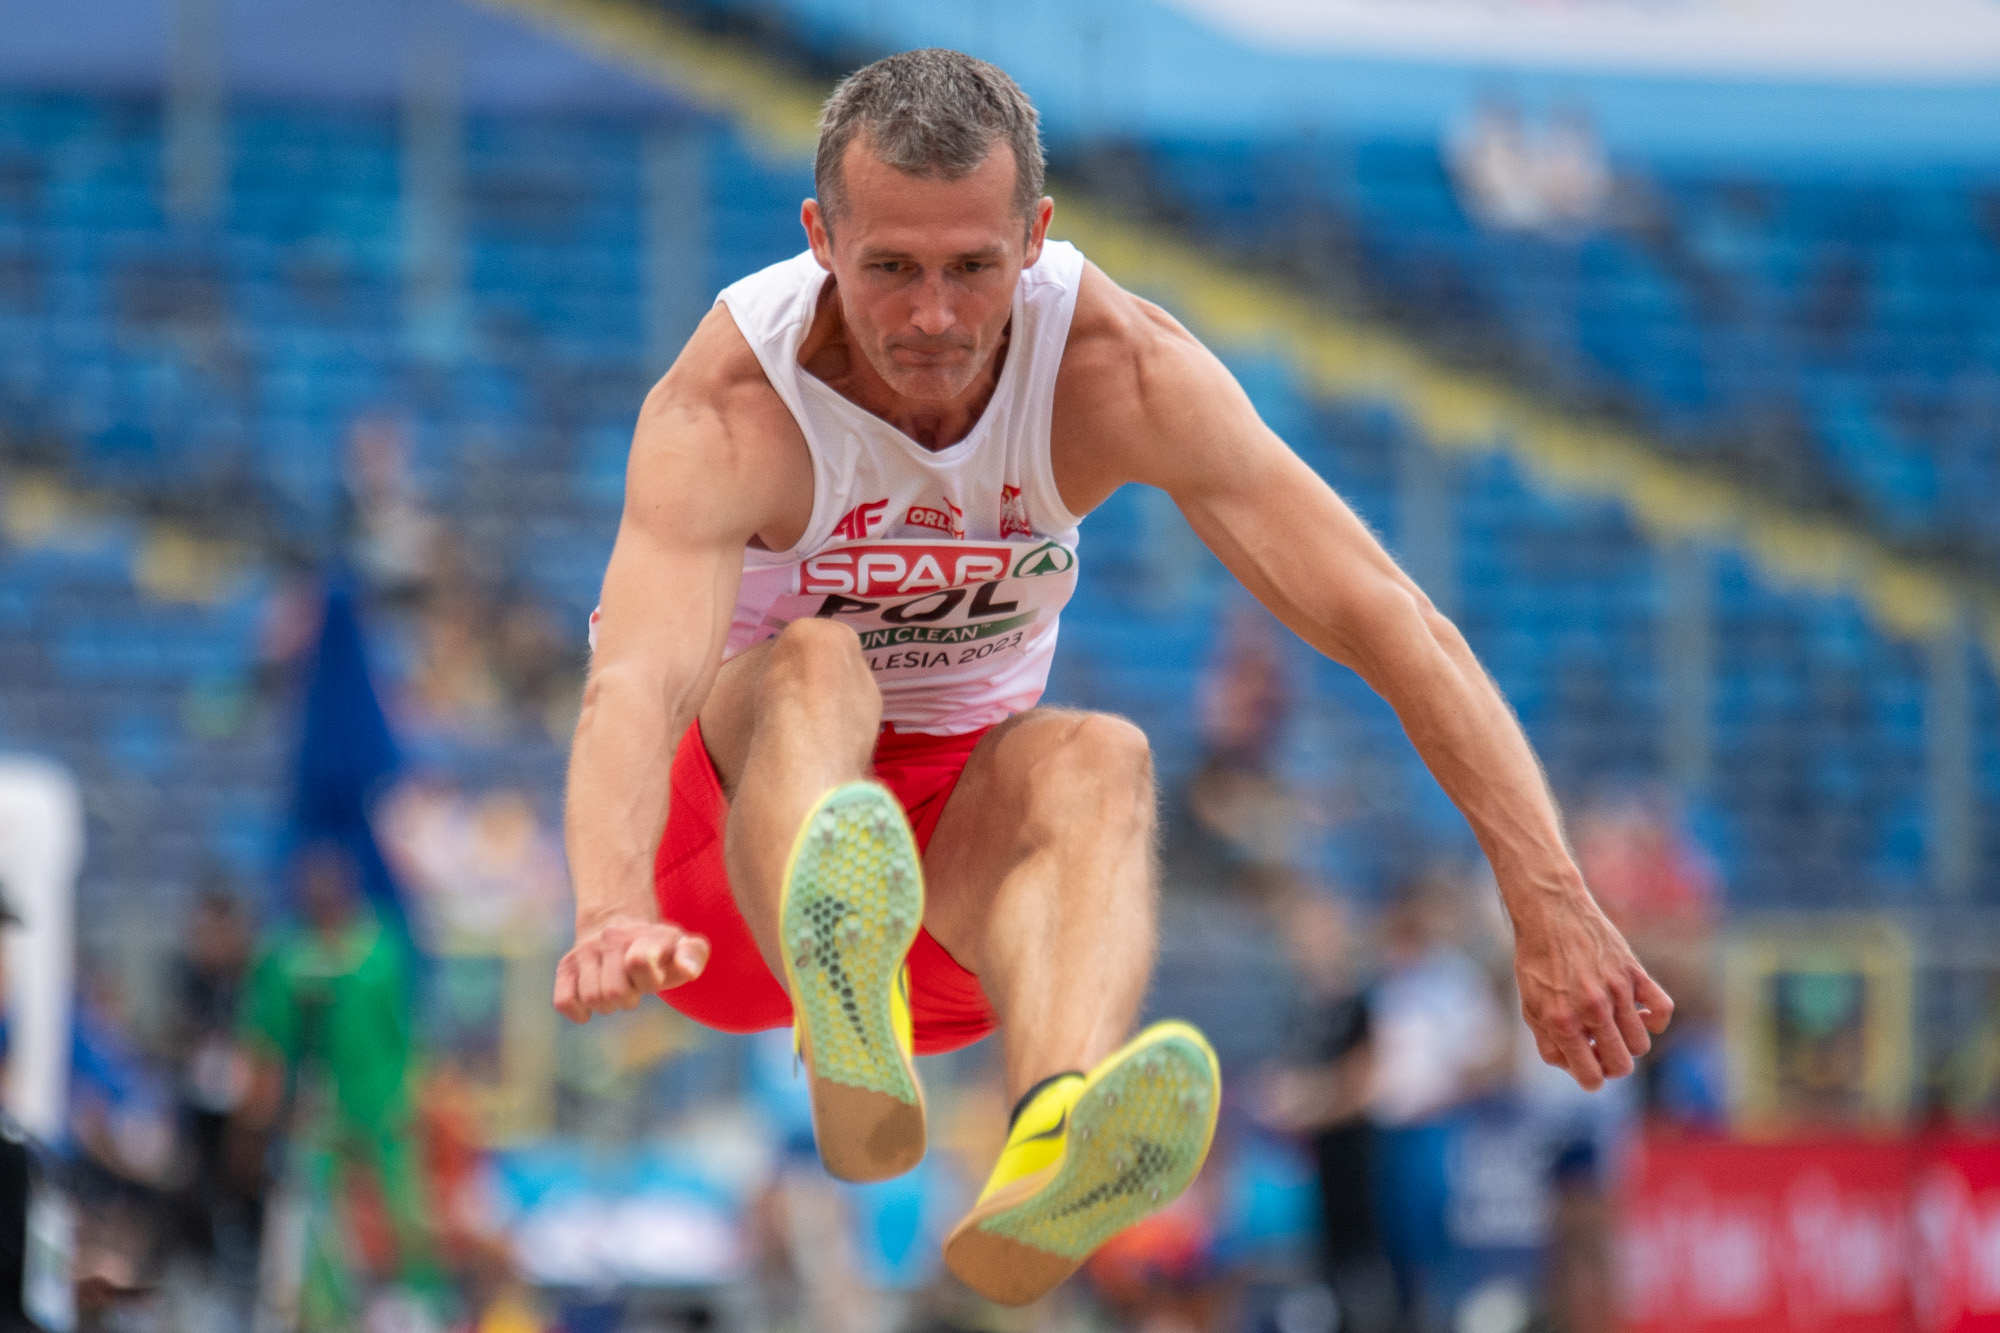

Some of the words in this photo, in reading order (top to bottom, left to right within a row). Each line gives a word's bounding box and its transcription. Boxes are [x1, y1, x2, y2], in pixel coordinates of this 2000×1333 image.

[909, 508, 953, 532] ORL
[805, 553, 1004, 595] SPAR
[814, 580, 1018, 623] POL
[861, 629, 890, 649] UN
[868, 650, 950, 672] LESIA
[957, 631, 1024, 665] 2023
